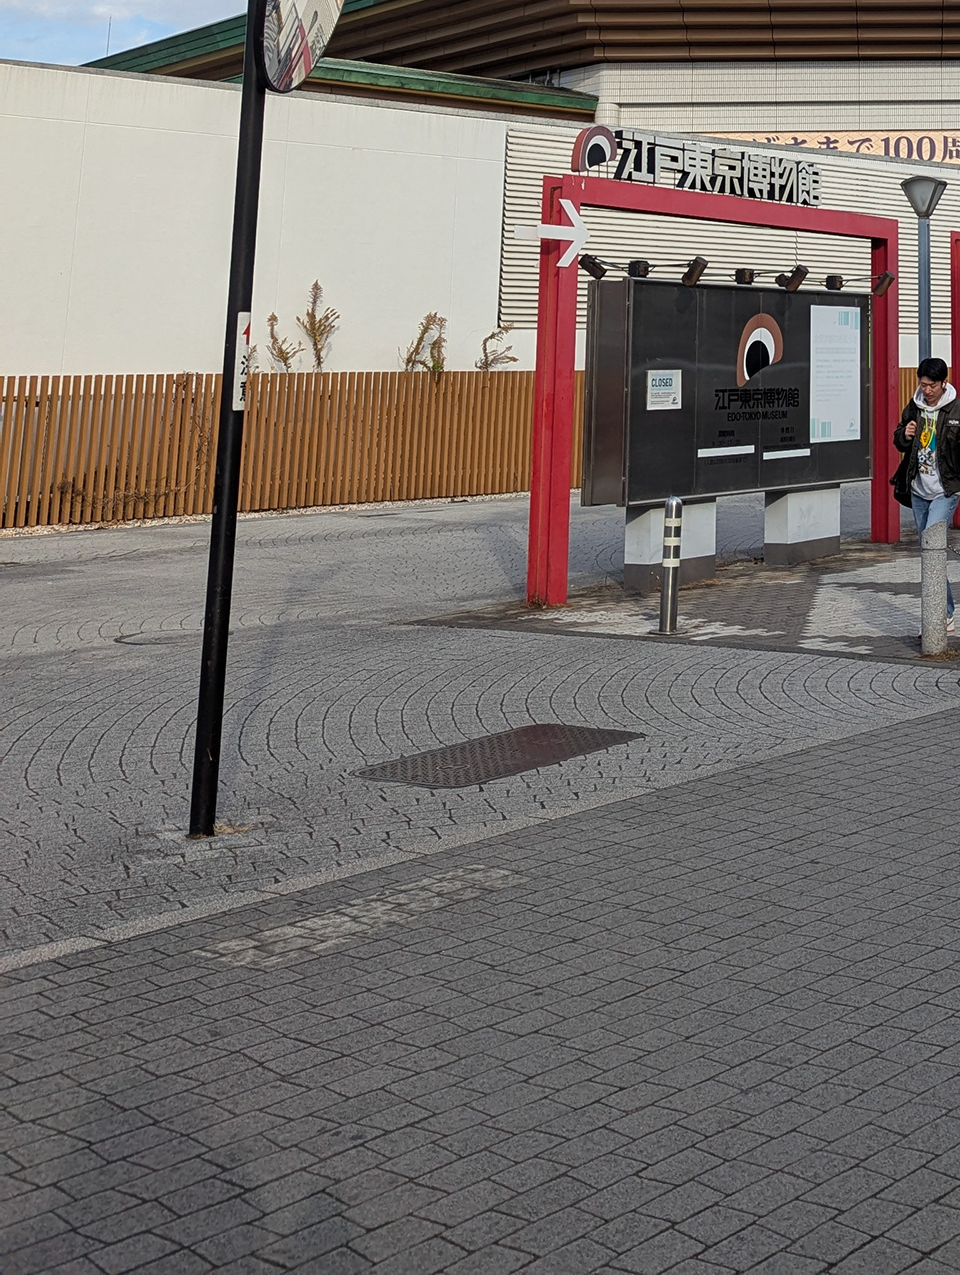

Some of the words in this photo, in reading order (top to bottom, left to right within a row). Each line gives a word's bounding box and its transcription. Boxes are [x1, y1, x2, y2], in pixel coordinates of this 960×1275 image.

[614, 128, 823, 207] 江戸東京博物館
[651, 377, 674, 388] CLOSED
[714, 387, 800, 411] 江戸東京博物館
[727, 410, 761, 422] EDO-TOKYO
[761, 409, 788, 421] MUSEUM
